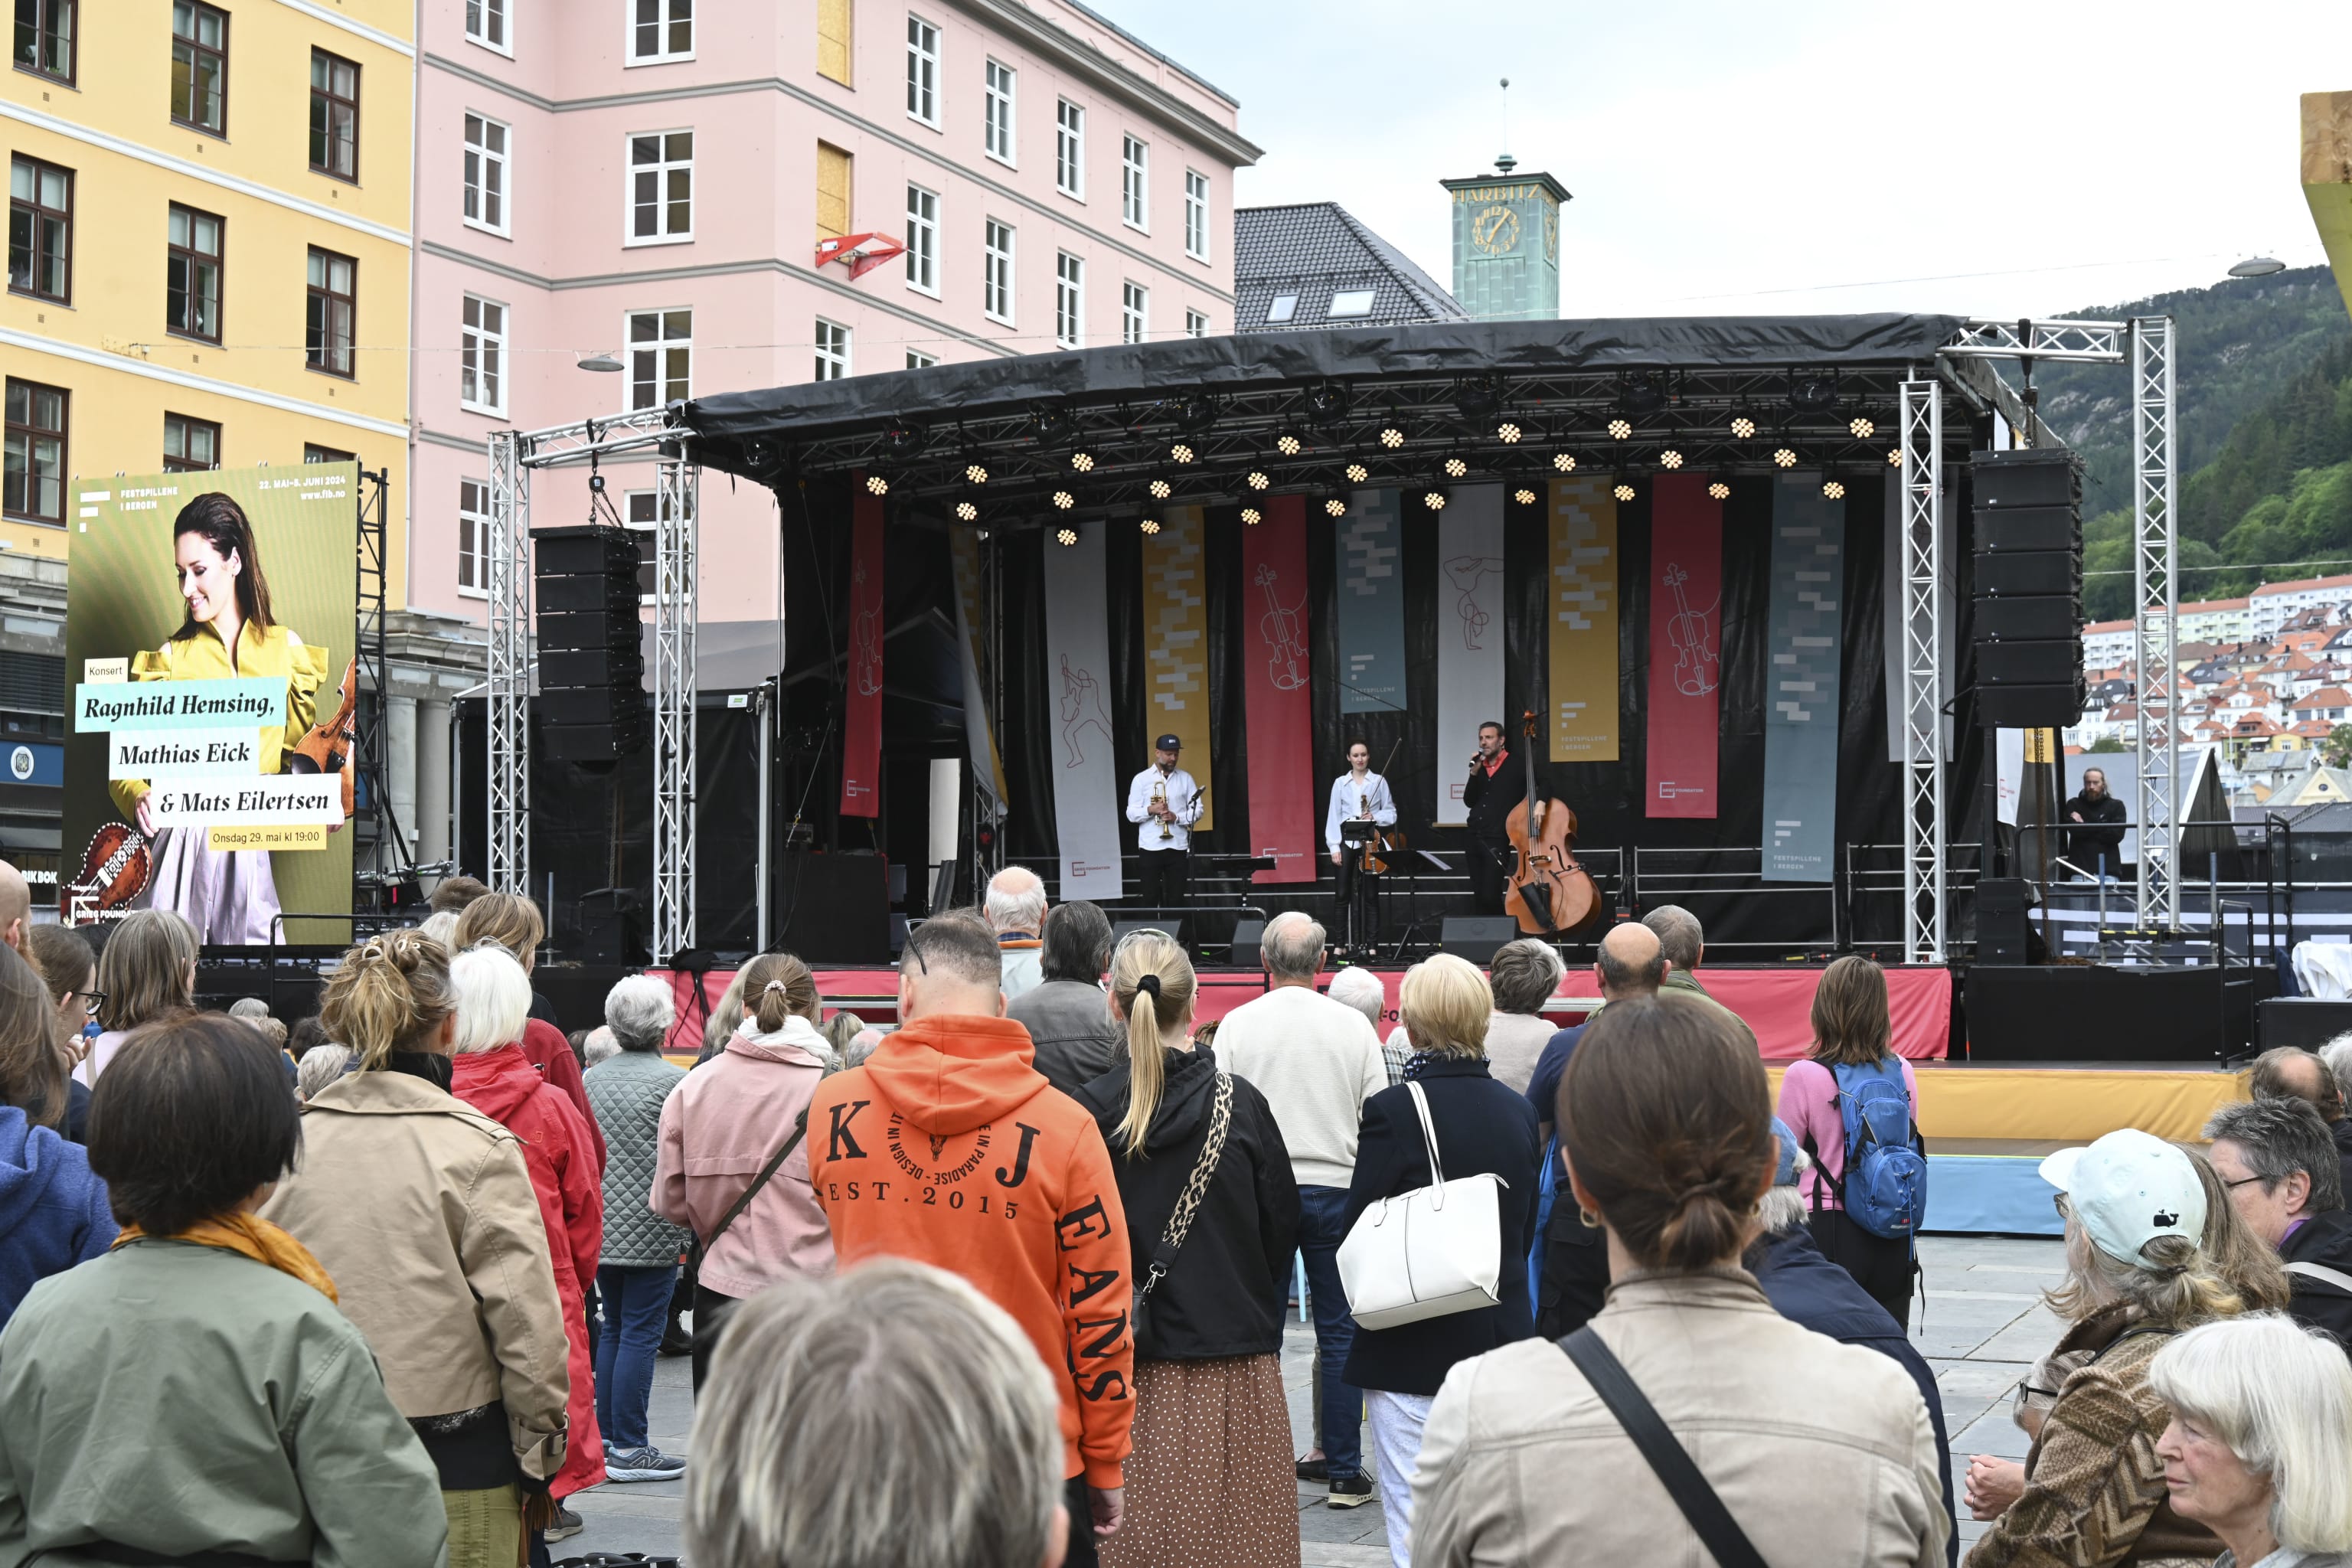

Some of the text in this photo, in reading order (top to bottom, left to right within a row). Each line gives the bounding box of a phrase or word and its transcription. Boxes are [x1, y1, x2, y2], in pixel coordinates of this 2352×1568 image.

[1452, 184, 1541, 204] HARBITZ
[259, 481, 272, 490] 22.
[302, 476, 323, 487] JUNI
[325, 475, 345, 485] 2024
[120, 486, 178, 498] FESTSPILLENE
[120, 501, 157, 511] I BERGEN
[89, 666, 122, 676] Konsert
[83, 693, 275, 722] Ragnhild Hemsing,
[119, 742, 250, 765] Mathias Eick
[160, 791, 329, 812] & Mats Eilertsen
[213, 831, 319, 844] Onsdag 29. mai kl 19:00
[38, 871, 58, 884] BOK
[889, 1142, 923, 1180] DESIGN
[933, 1148, 985, 1185] PARADISE
